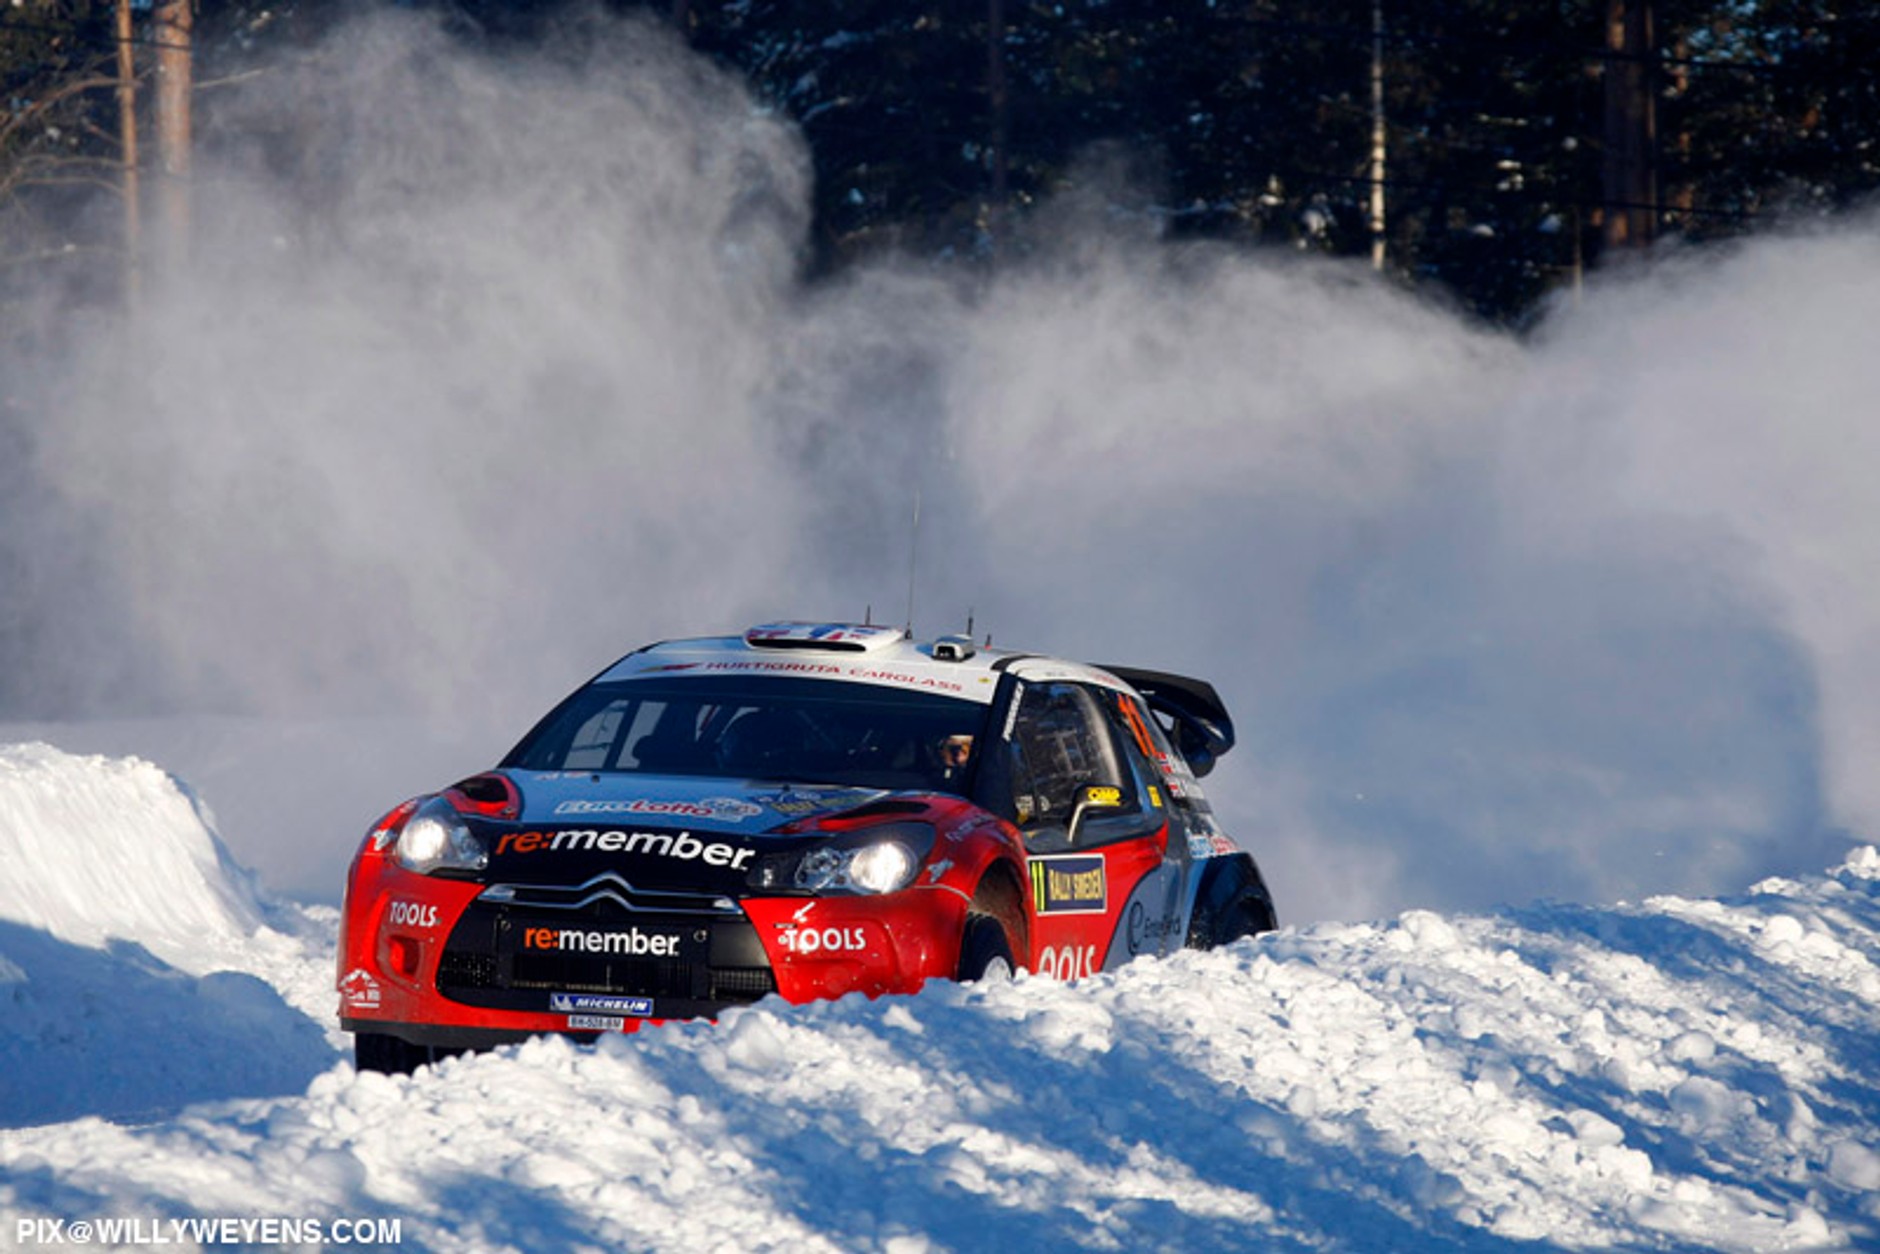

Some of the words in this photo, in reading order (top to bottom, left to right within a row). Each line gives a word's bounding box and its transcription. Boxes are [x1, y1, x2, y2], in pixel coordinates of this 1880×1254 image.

[849, 667, 962, 692] CARGLASS
[1048, 869, 1072, 901] RALLY
[1073, 867, 1103, 900] SWEDEN
[390, 901, 438, 928] TOOLS
[784, 927, 867, 952] TOOLS
[575, 997, 648, 1011] MICHELIN
